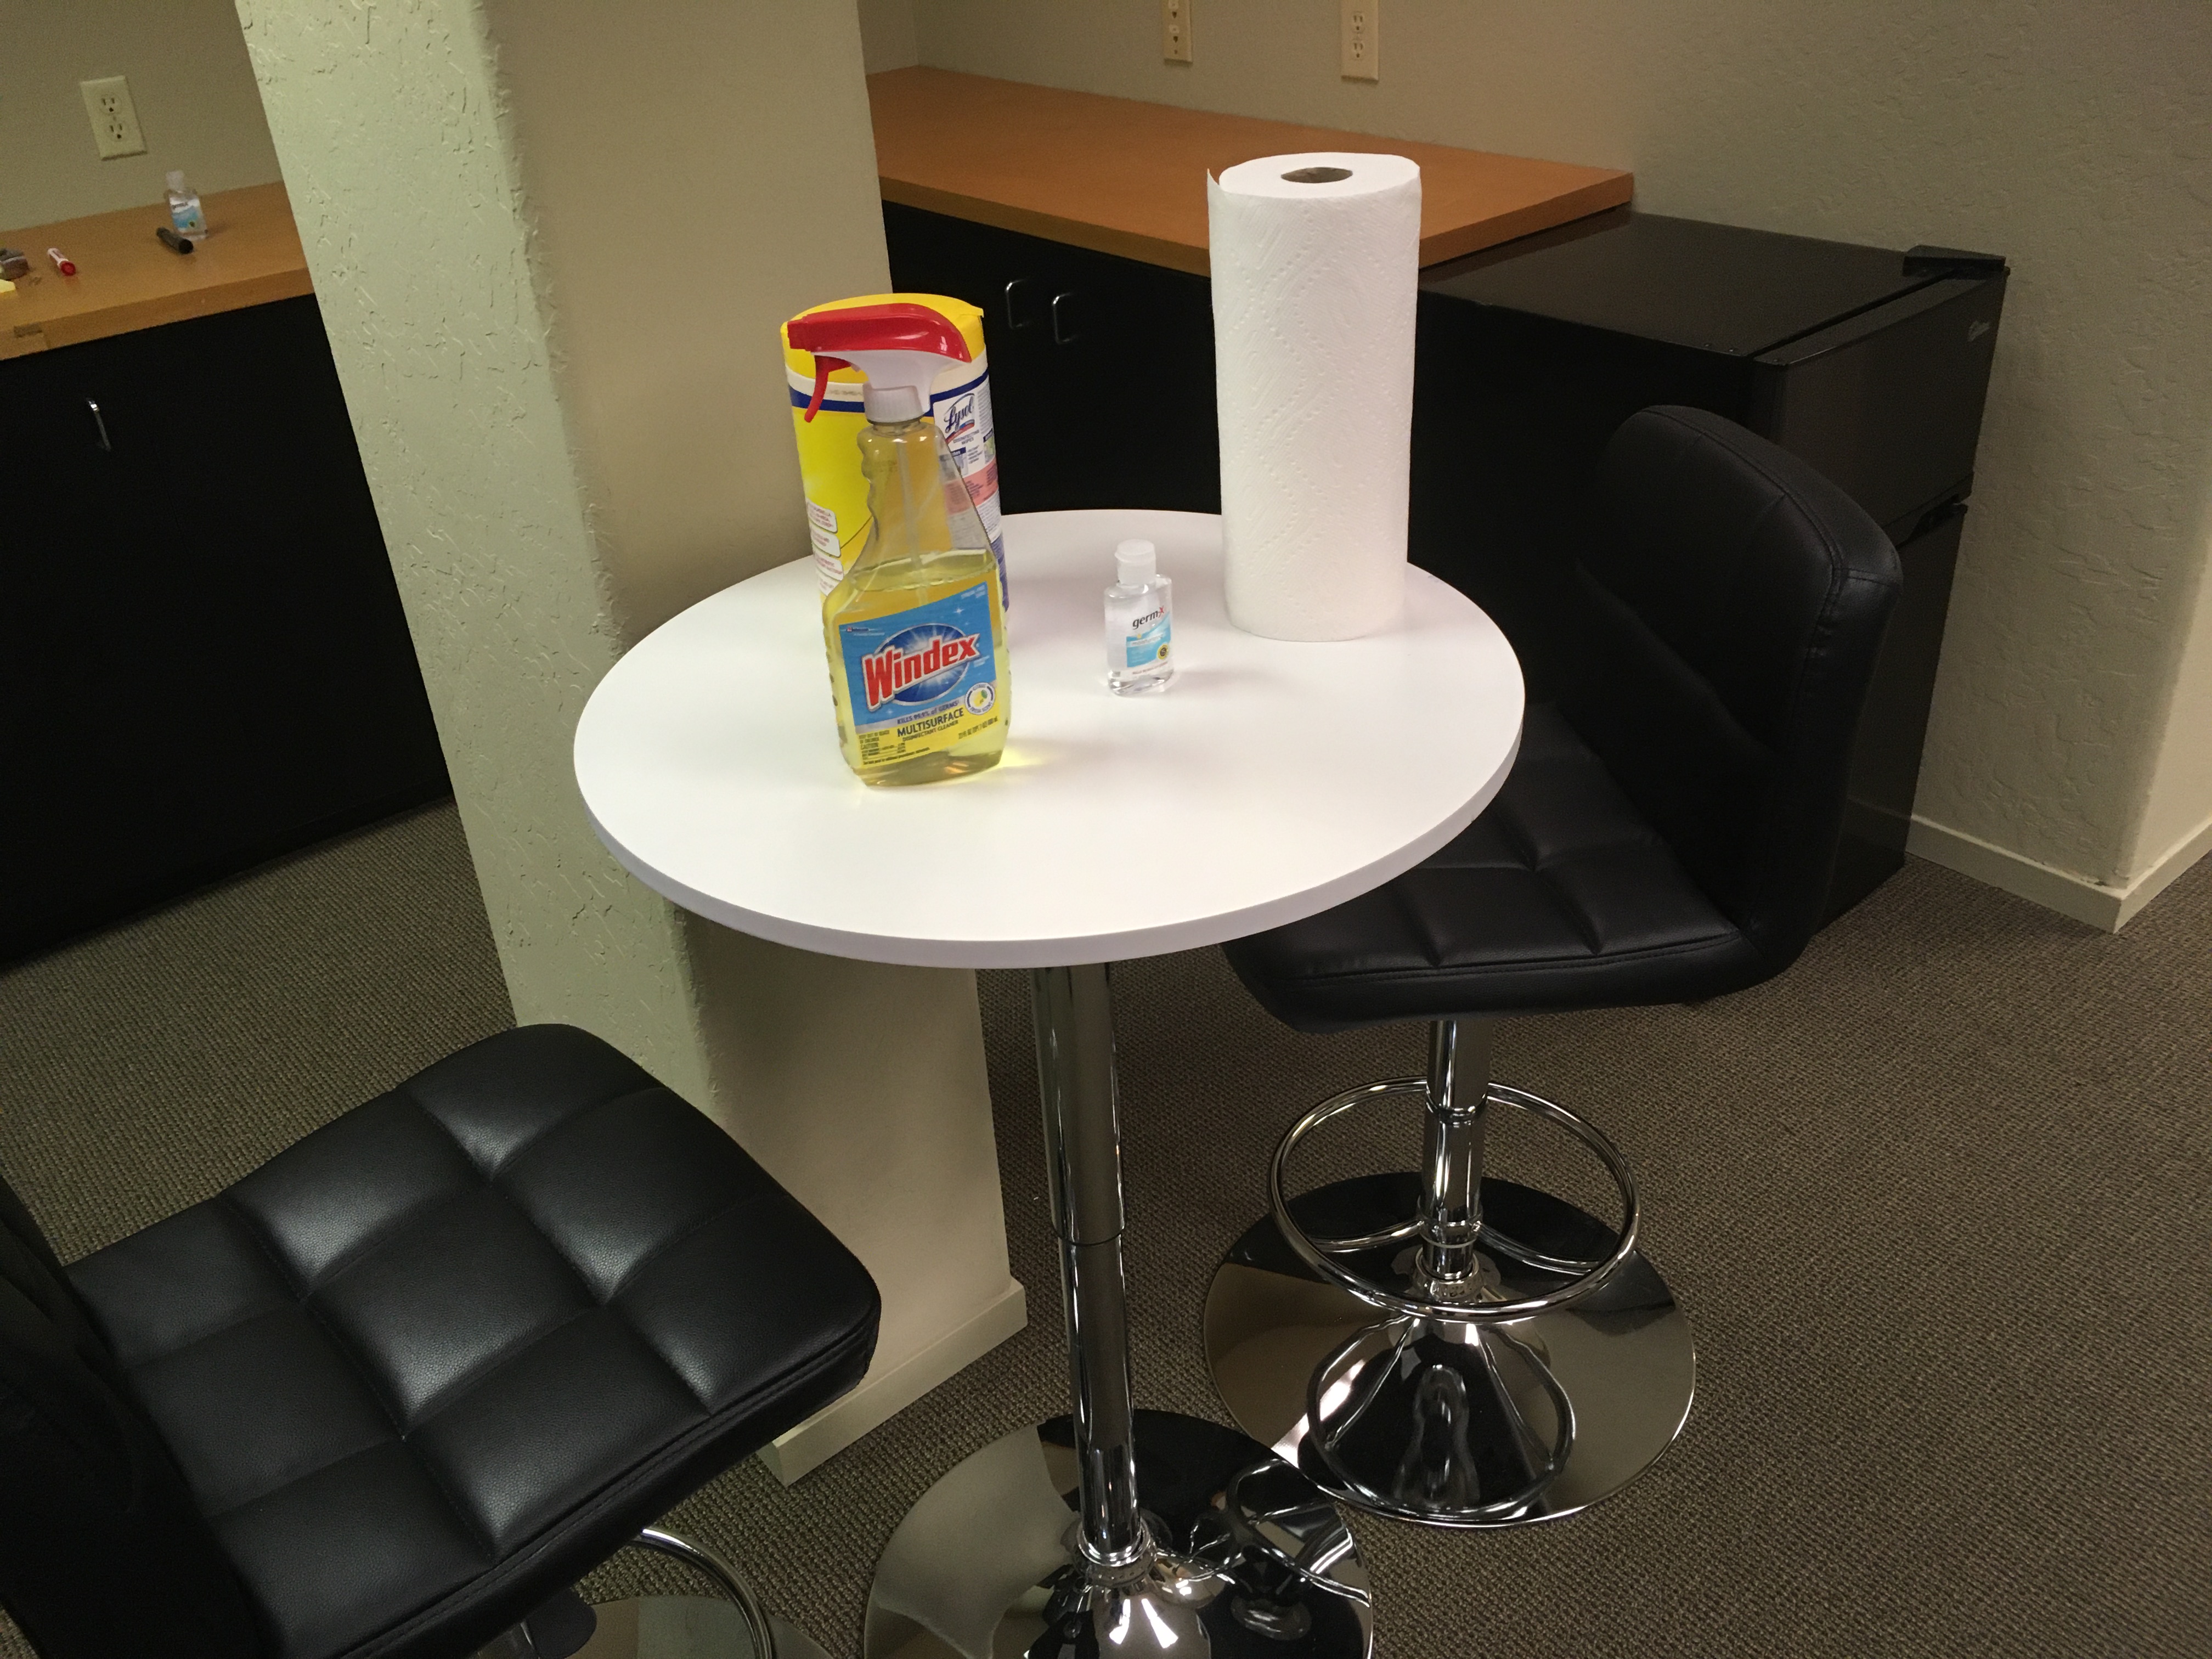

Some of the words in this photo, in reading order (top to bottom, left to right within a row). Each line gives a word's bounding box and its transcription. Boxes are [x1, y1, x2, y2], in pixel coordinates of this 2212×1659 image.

[944, 393, 974, 433] Lysol
[864, 635, 979, 708] Windex
[897, 707, 964, 737] MULTISURFACE
